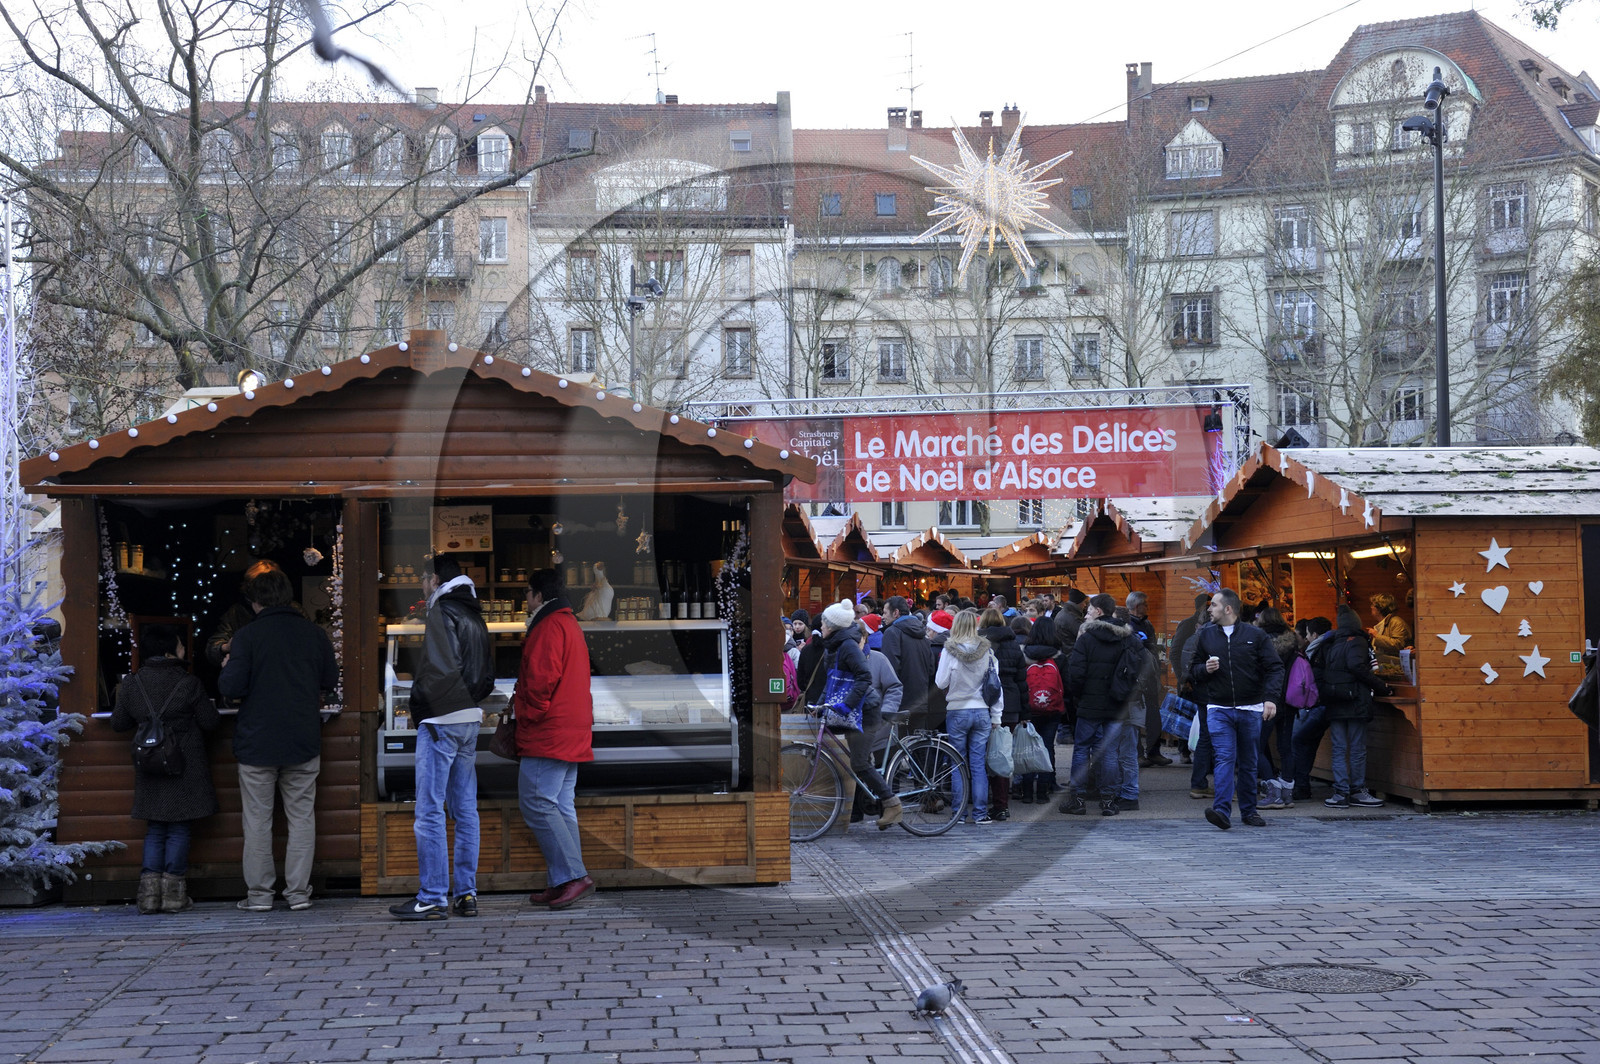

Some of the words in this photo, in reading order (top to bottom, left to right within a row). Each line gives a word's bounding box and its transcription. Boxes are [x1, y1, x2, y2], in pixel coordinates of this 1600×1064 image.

[799, 430, 839, 440] Strasbourg
[855, 431, 886, 458] Le
[894, 426, 1003, 458] Marché
[1011, 424, 1064, 455] des
[1072, 422, 1178, 454] Délices
[790, 438, 831, 450] Capitale
[855, 463, 891, 493] de
[899, 460, 964, 491] Noël
[973, 460, 1097, 490] d'Alsace
[773, 681, 780, 690] 12
